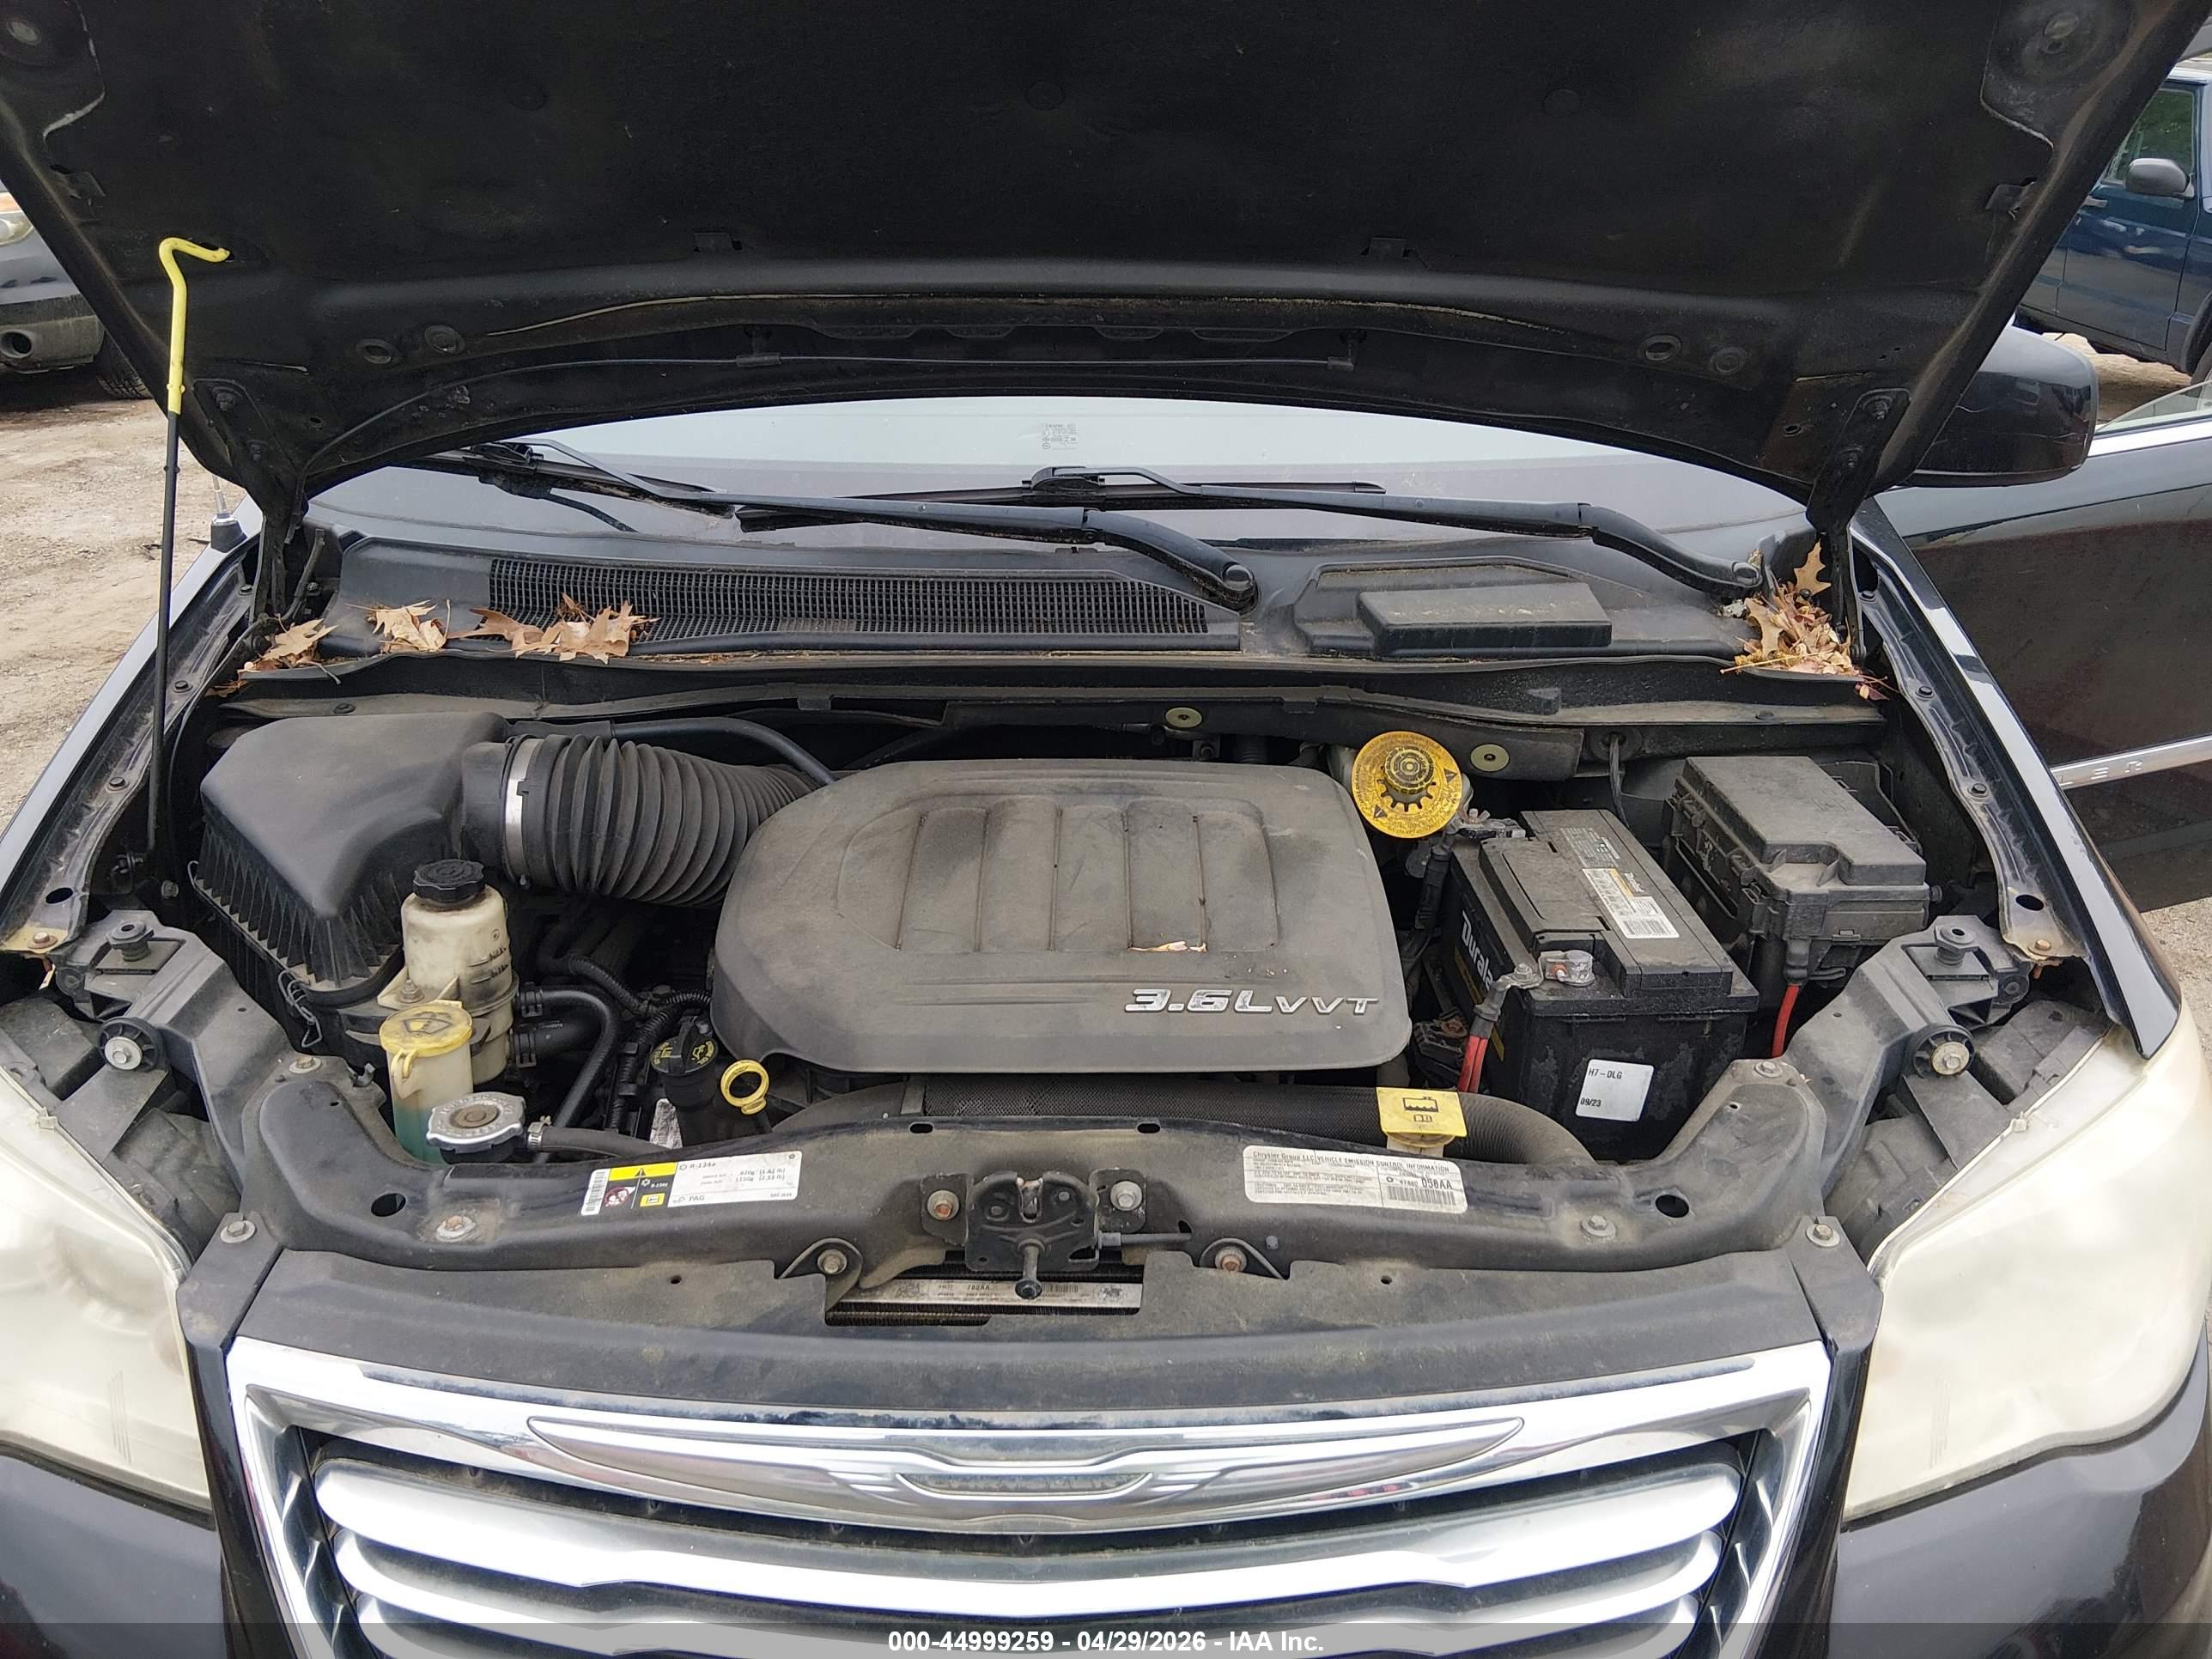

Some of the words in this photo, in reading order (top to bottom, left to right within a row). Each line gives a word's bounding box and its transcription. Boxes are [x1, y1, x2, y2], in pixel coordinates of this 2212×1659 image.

[1462, 909, 1493, 991] Durala
[1125, 988, 1273, 1012] 3.6L
[1275, 995, 1379, 1014] VVT
[1580, 1097, 1601, 1107] 09/23
[1281, 1152, 1301, 1162] Group
[1407, 1163, 1449, 1172] INFORMATION
